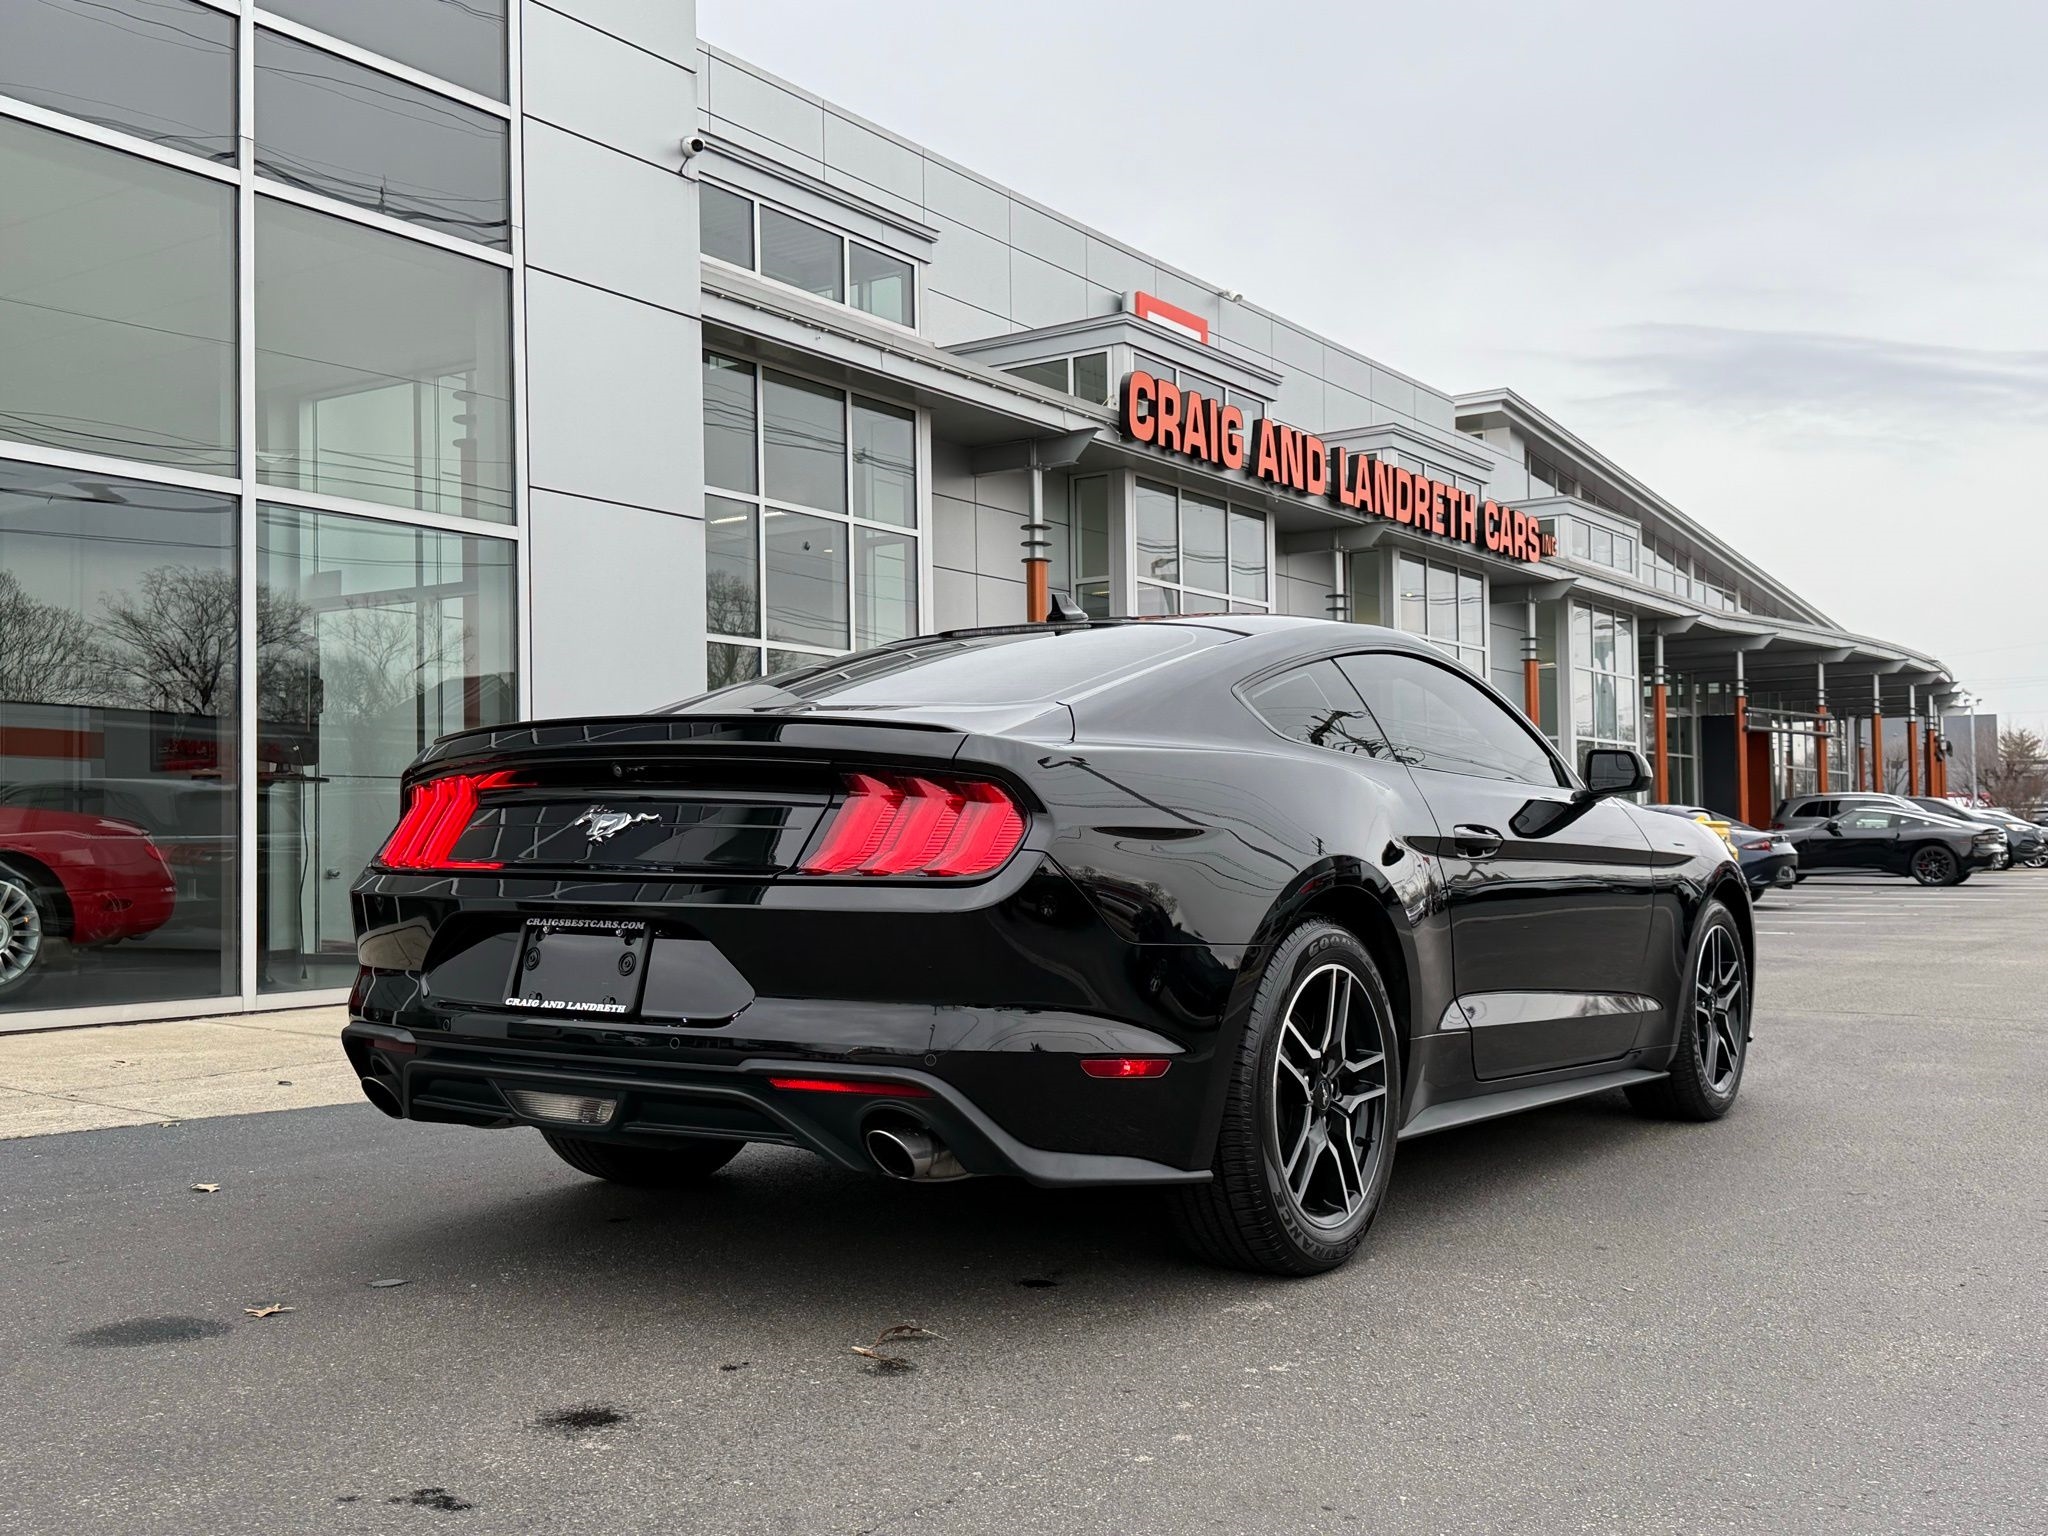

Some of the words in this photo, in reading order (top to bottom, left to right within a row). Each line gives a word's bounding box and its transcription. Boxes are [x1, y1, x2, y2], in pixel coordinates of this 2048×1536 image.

[1127, 370, 1244, 470] CRAIG
[1256, 418, 1327, 496] AND
[1338, 446, 1477, 544] LANDRETH
[1484, 501, 1540, 563] CARS
[1542, 533, 1558, 557] INC
[526, 918, 646, 930] CRAIGSBESTCARS.COM
[505, 998, 540, 1008] CRAIG
[541, 1000, 565, 1009] AND
[566, 1002, 626, 1013] LANDRETH
